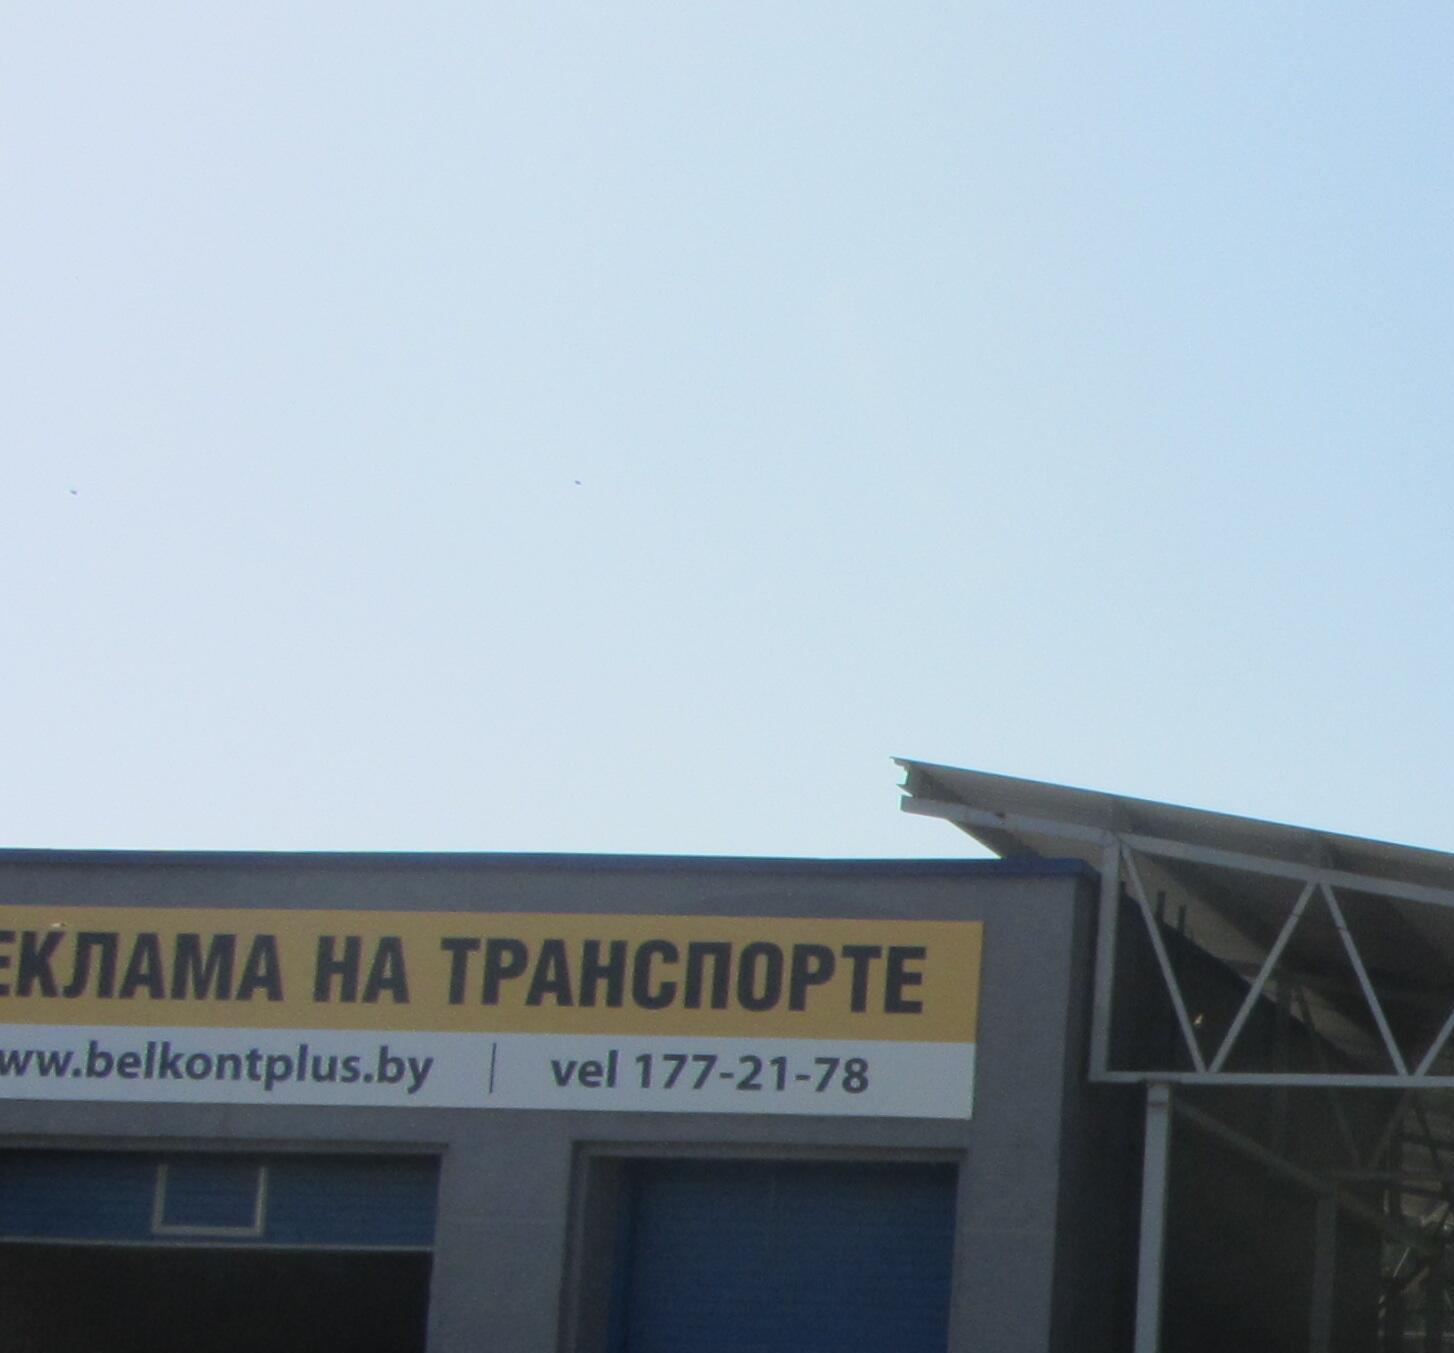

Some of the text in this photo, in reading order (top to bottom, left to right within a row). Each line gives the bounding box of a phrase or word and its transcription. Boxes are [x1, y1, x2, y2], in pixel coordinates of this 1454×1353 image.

[313, 934, 411, 1004] НА
[441, 938, 927, 1014] ТРАНСПОРТЕ
[551, 1050, 618, 1088] vel
[634, 1053, 870, 1094] 177-21-78
